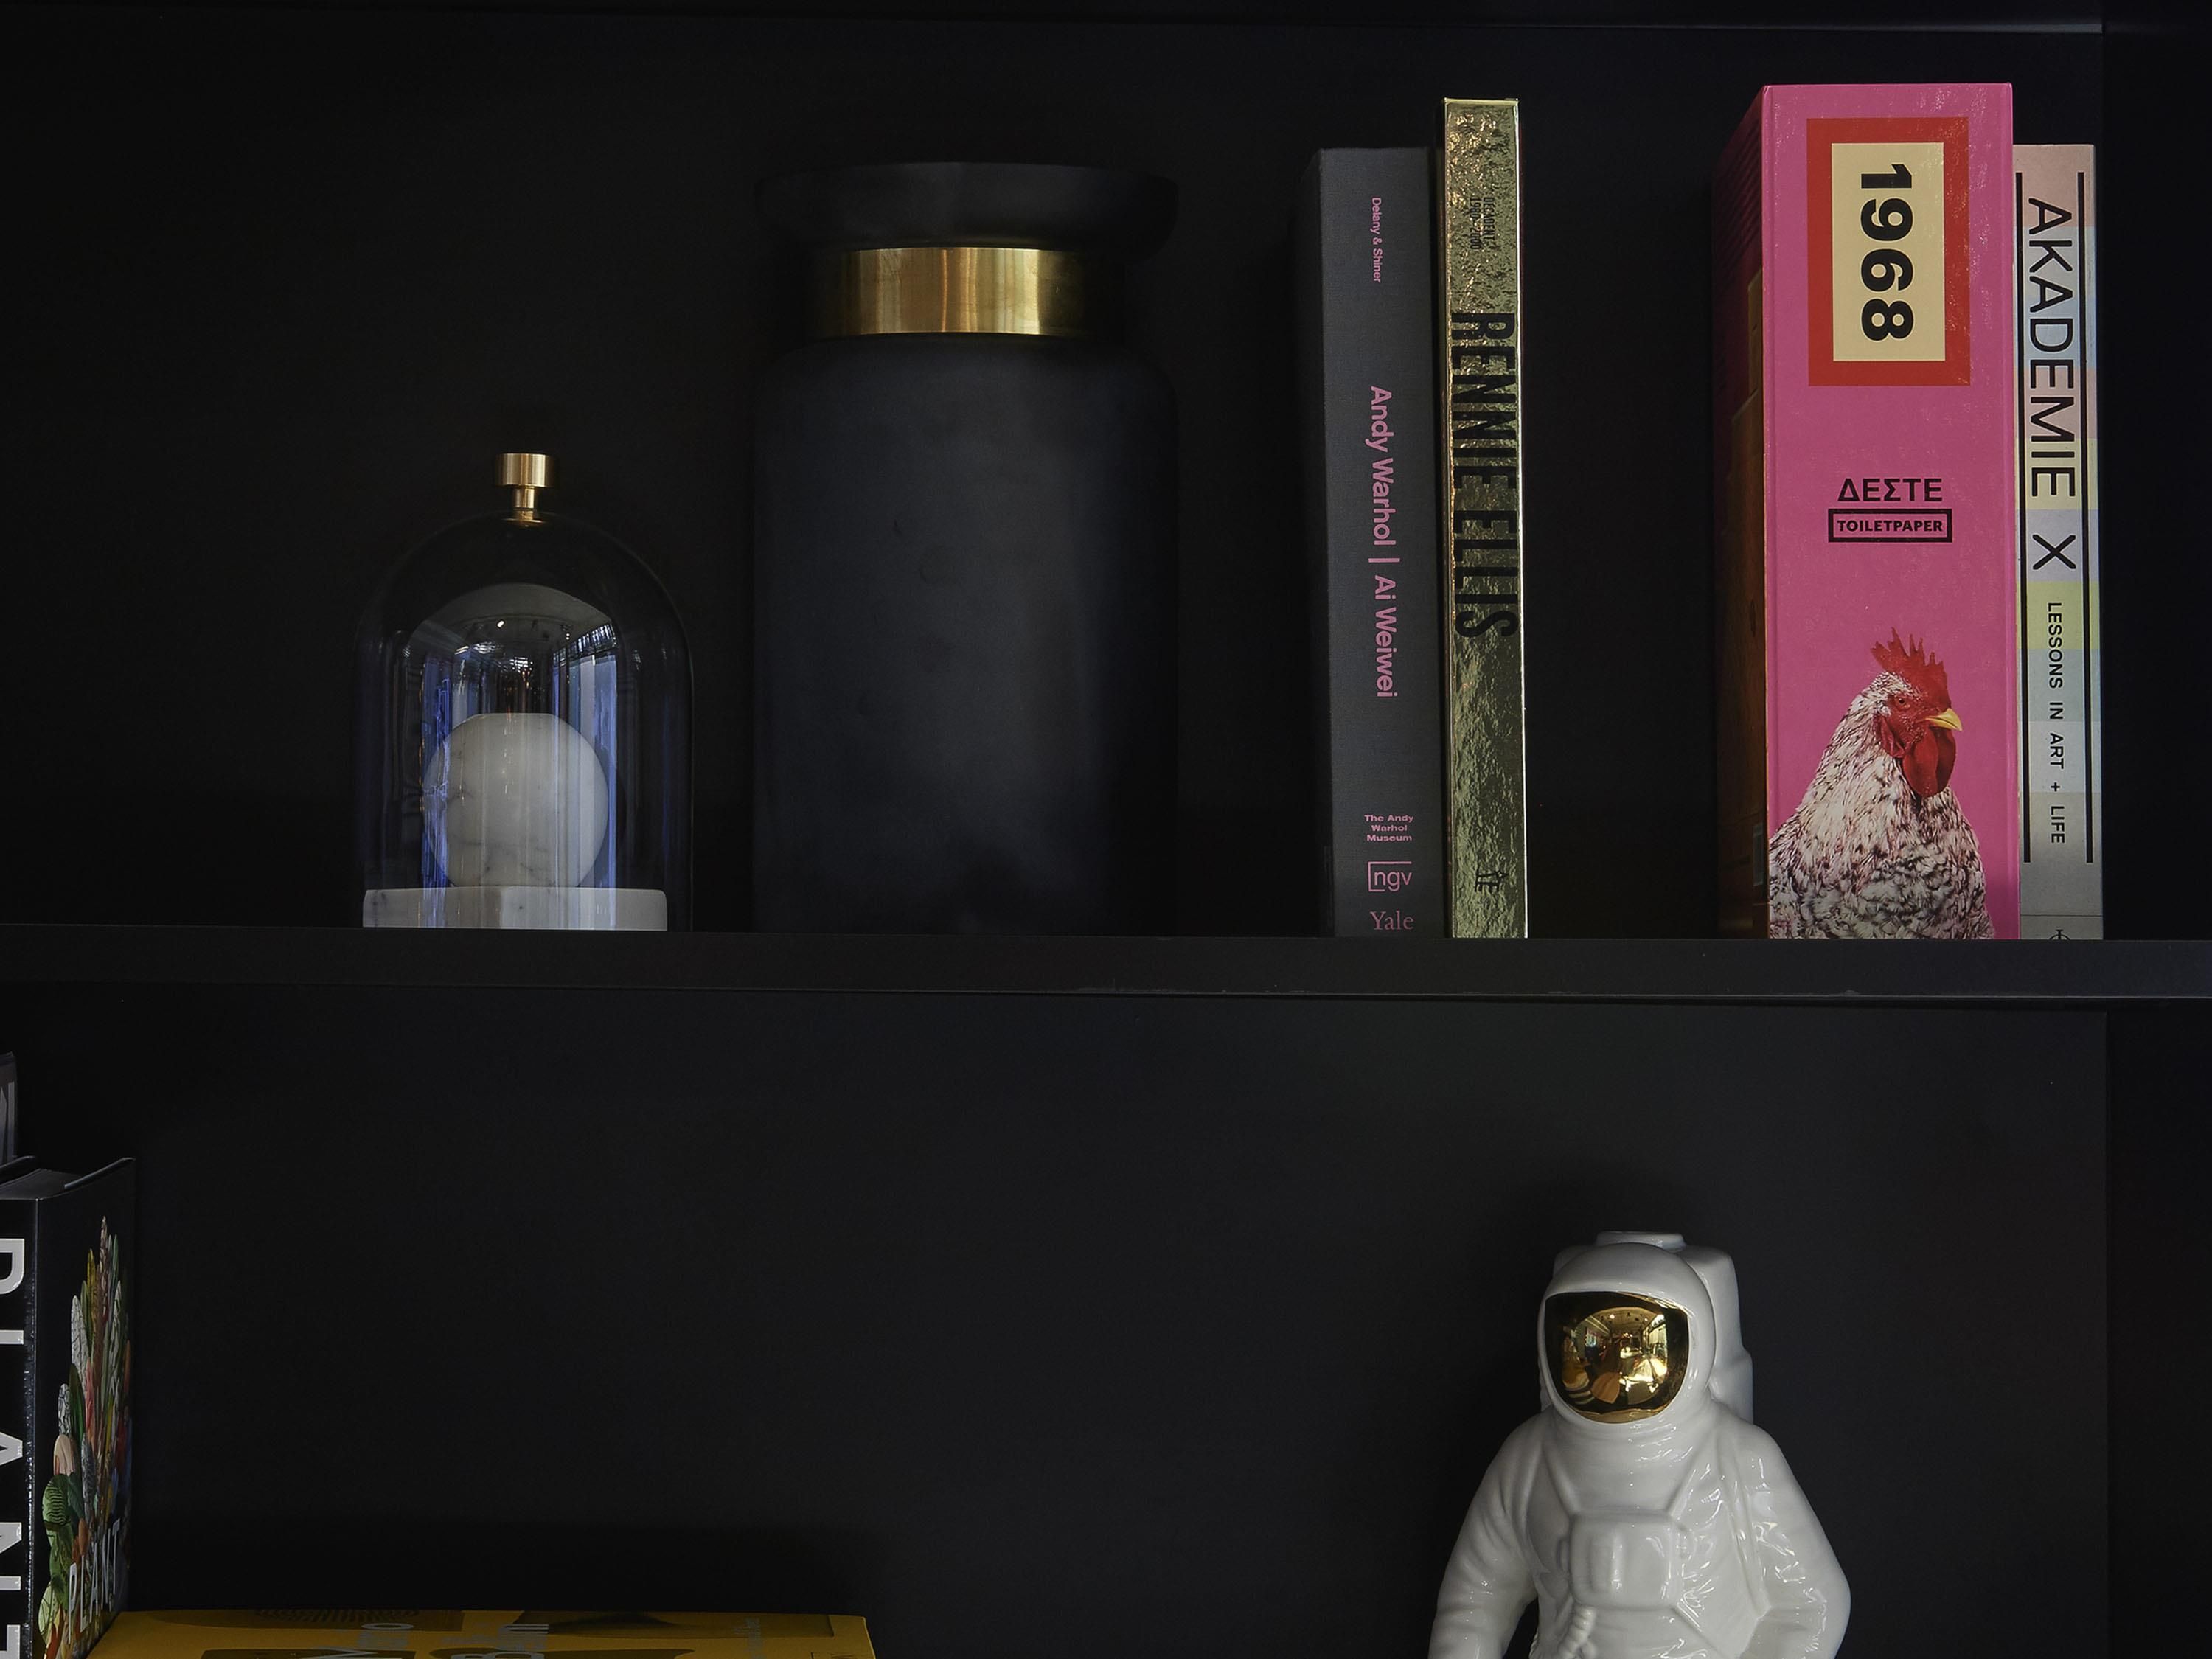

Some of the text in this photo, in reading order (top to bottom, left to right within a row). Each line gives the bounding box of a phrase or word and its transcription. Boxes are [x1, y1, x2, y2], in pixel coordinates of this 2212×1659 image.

[1369, 196, 1384, 283] Delany & Shiner
[1860, 163, 1914, 341] 1968
[2028, 197, 2076, 570] AKADEMIE X
[1364, 385, 1394, 453] Andy
[1451, 313, 1519, 638] RENNIE ELLIS
[1837, 478, 1943, 502] ΔΕΣΤΕ
[1371, 457, 1397, 546] Warhol
[1837, 519, 1943, 532] TOILETPAPER
[1374, 574, 1397, 601] Ai
[1374, 606, 1399, 698] Weiwei
[2047, 601, 2064, 689] LESSONS
[2049, 701, 2064, 720] IN
[2049, 732, 2065, 769] ART
[1364, 813, 1413, 824] The Andy
[1370, 824, 1408, 832] Warhol
[2050, 805, 2065, 844] LIFE
[1366, 834, 1413, 842] Museum
[1373, 870, 1413, 892] ngv
[1369, 908, 1415, 931] Yale
[68, 1517, 121, 1645] PLANT
